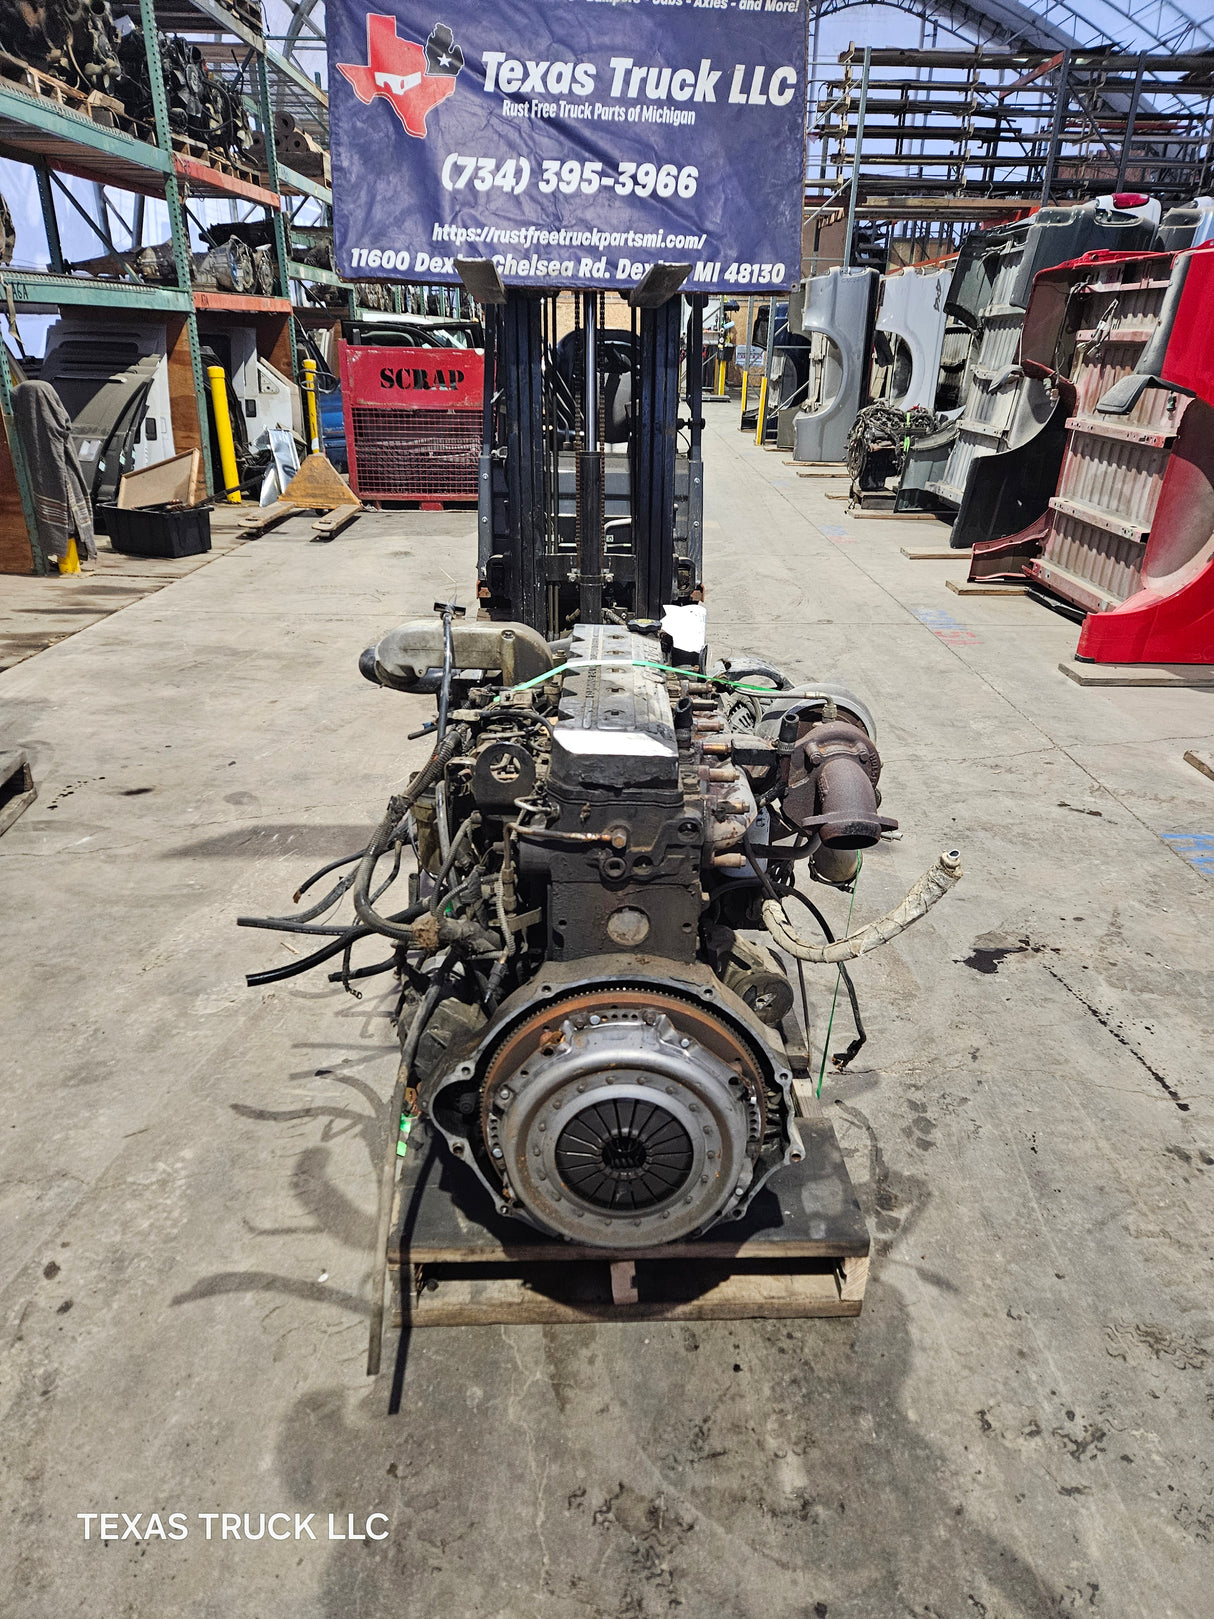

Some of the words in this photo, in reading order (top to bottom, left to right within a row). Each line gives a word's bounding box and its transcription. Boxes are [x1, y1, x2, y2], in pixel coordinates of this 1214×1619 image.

[739, 0, 762, 11] and
[764, 0, 799, 12] More!
[481, 51, 597, 96] Texas
[609, 56, 723, 103] Truck
[728, 63, 797, 106] LLC
[502, 99, 530, 118] Rust
[531, 99, 557, 118] Free
[559, 100, 592, 120] Truck
[594, 102, 626, 122] Parts
[627, 104, 641, 122] of
[642, 104, 696, 126] Michigan
[441, 152, 531, 195] (734)
[538, 159, 699, 199] 395-3966
[432, 222, 707, 251] https://rustfreetruckpartsmi.com/
[351, 247, 410, 271] 11600
[491, 253, 575, 277] Chelsea
[578, 256, 611, 279] Rd.
[693, 261, 721, 283] MI
[724, 262, 786, 284] 48130
[380, 367, 465, 391] SCRAP
